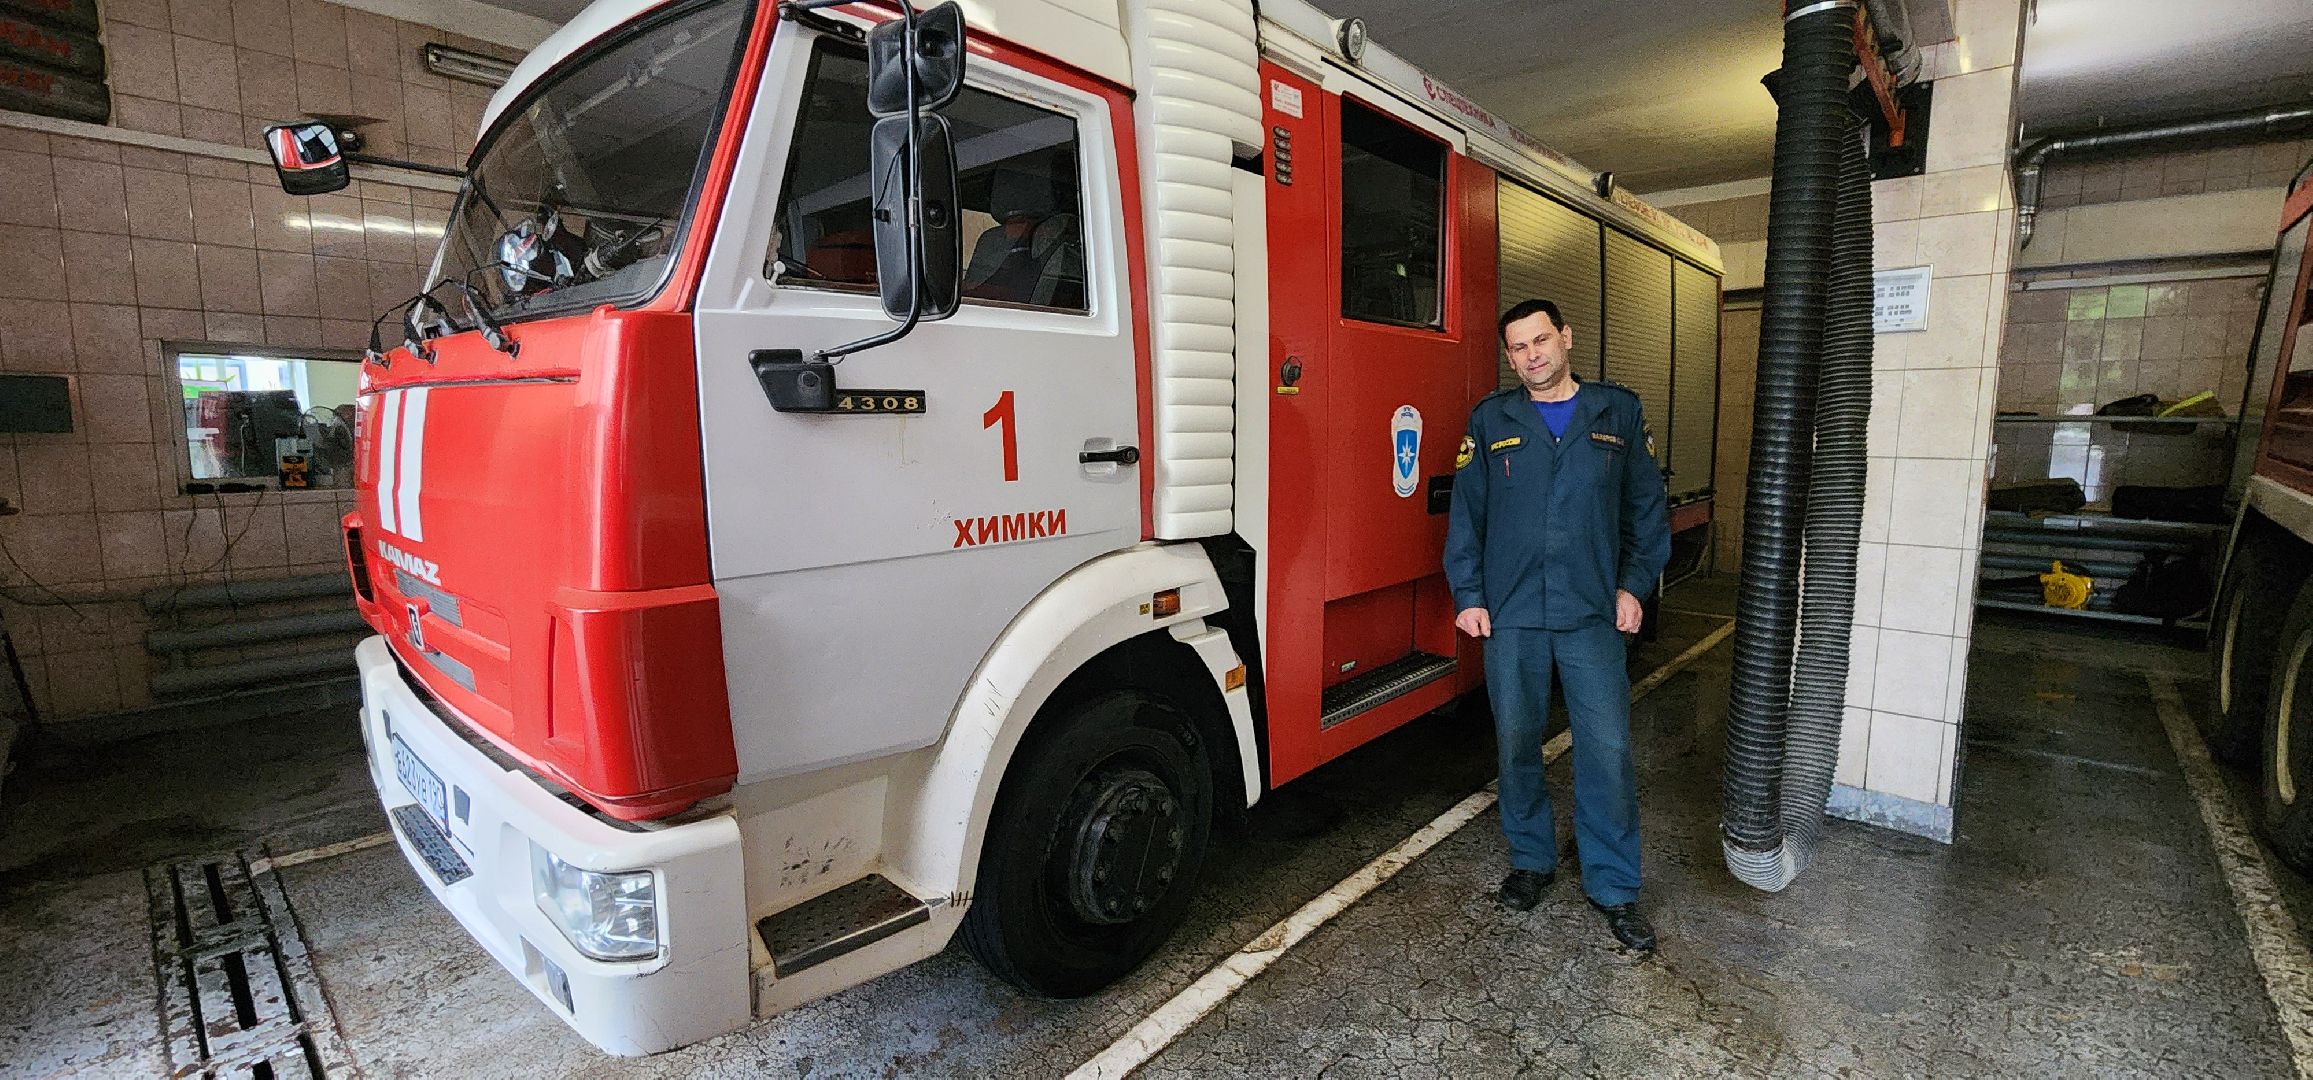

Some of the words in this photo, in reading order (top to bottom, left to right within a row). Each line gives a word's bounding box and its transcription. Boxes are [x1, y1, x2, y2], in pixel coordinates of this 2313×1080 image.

[838, 396, 919, 411] 4308
[983, 390, 1019, 482] 1
[953, 509, 1067, 549] ХИМКИ
[378, 539, 442, 587] KAMAZ
